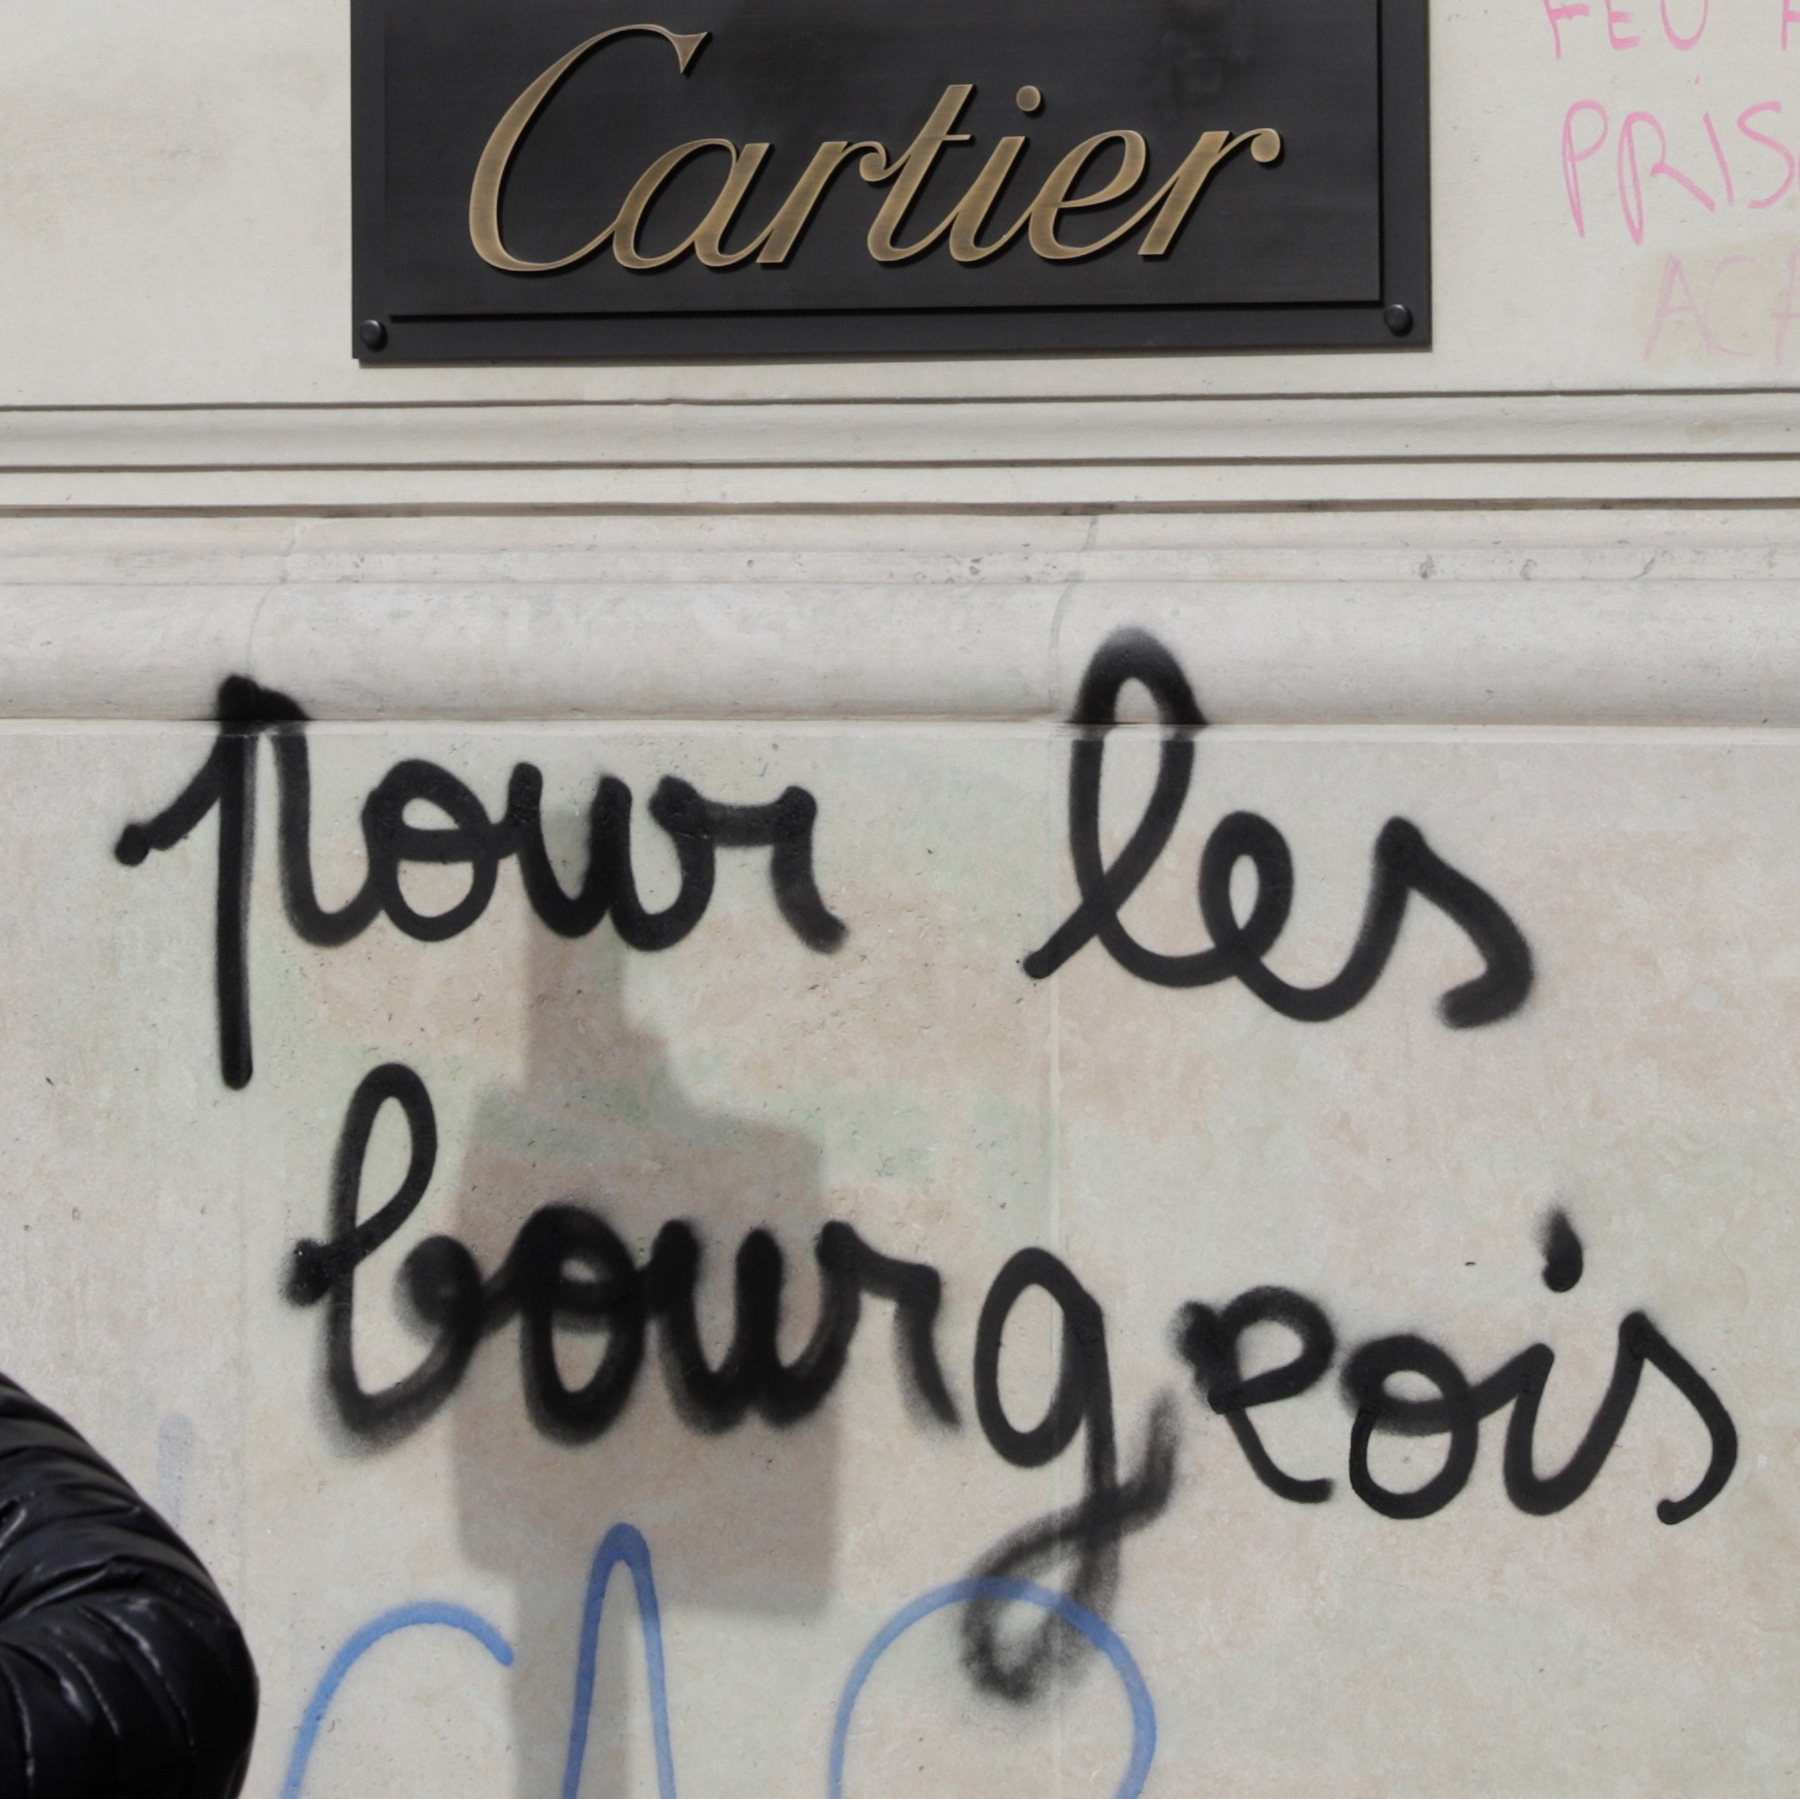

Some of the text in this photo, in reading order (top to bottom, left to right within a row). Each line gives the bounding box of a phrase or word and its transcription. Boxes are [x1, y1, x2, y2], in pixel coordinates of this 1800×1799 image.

[468, 23, 1281, 273] Cartier
[113, 629, 1535, 1089] pour les
[284, 1062, 1738, 1706] bourgeois
